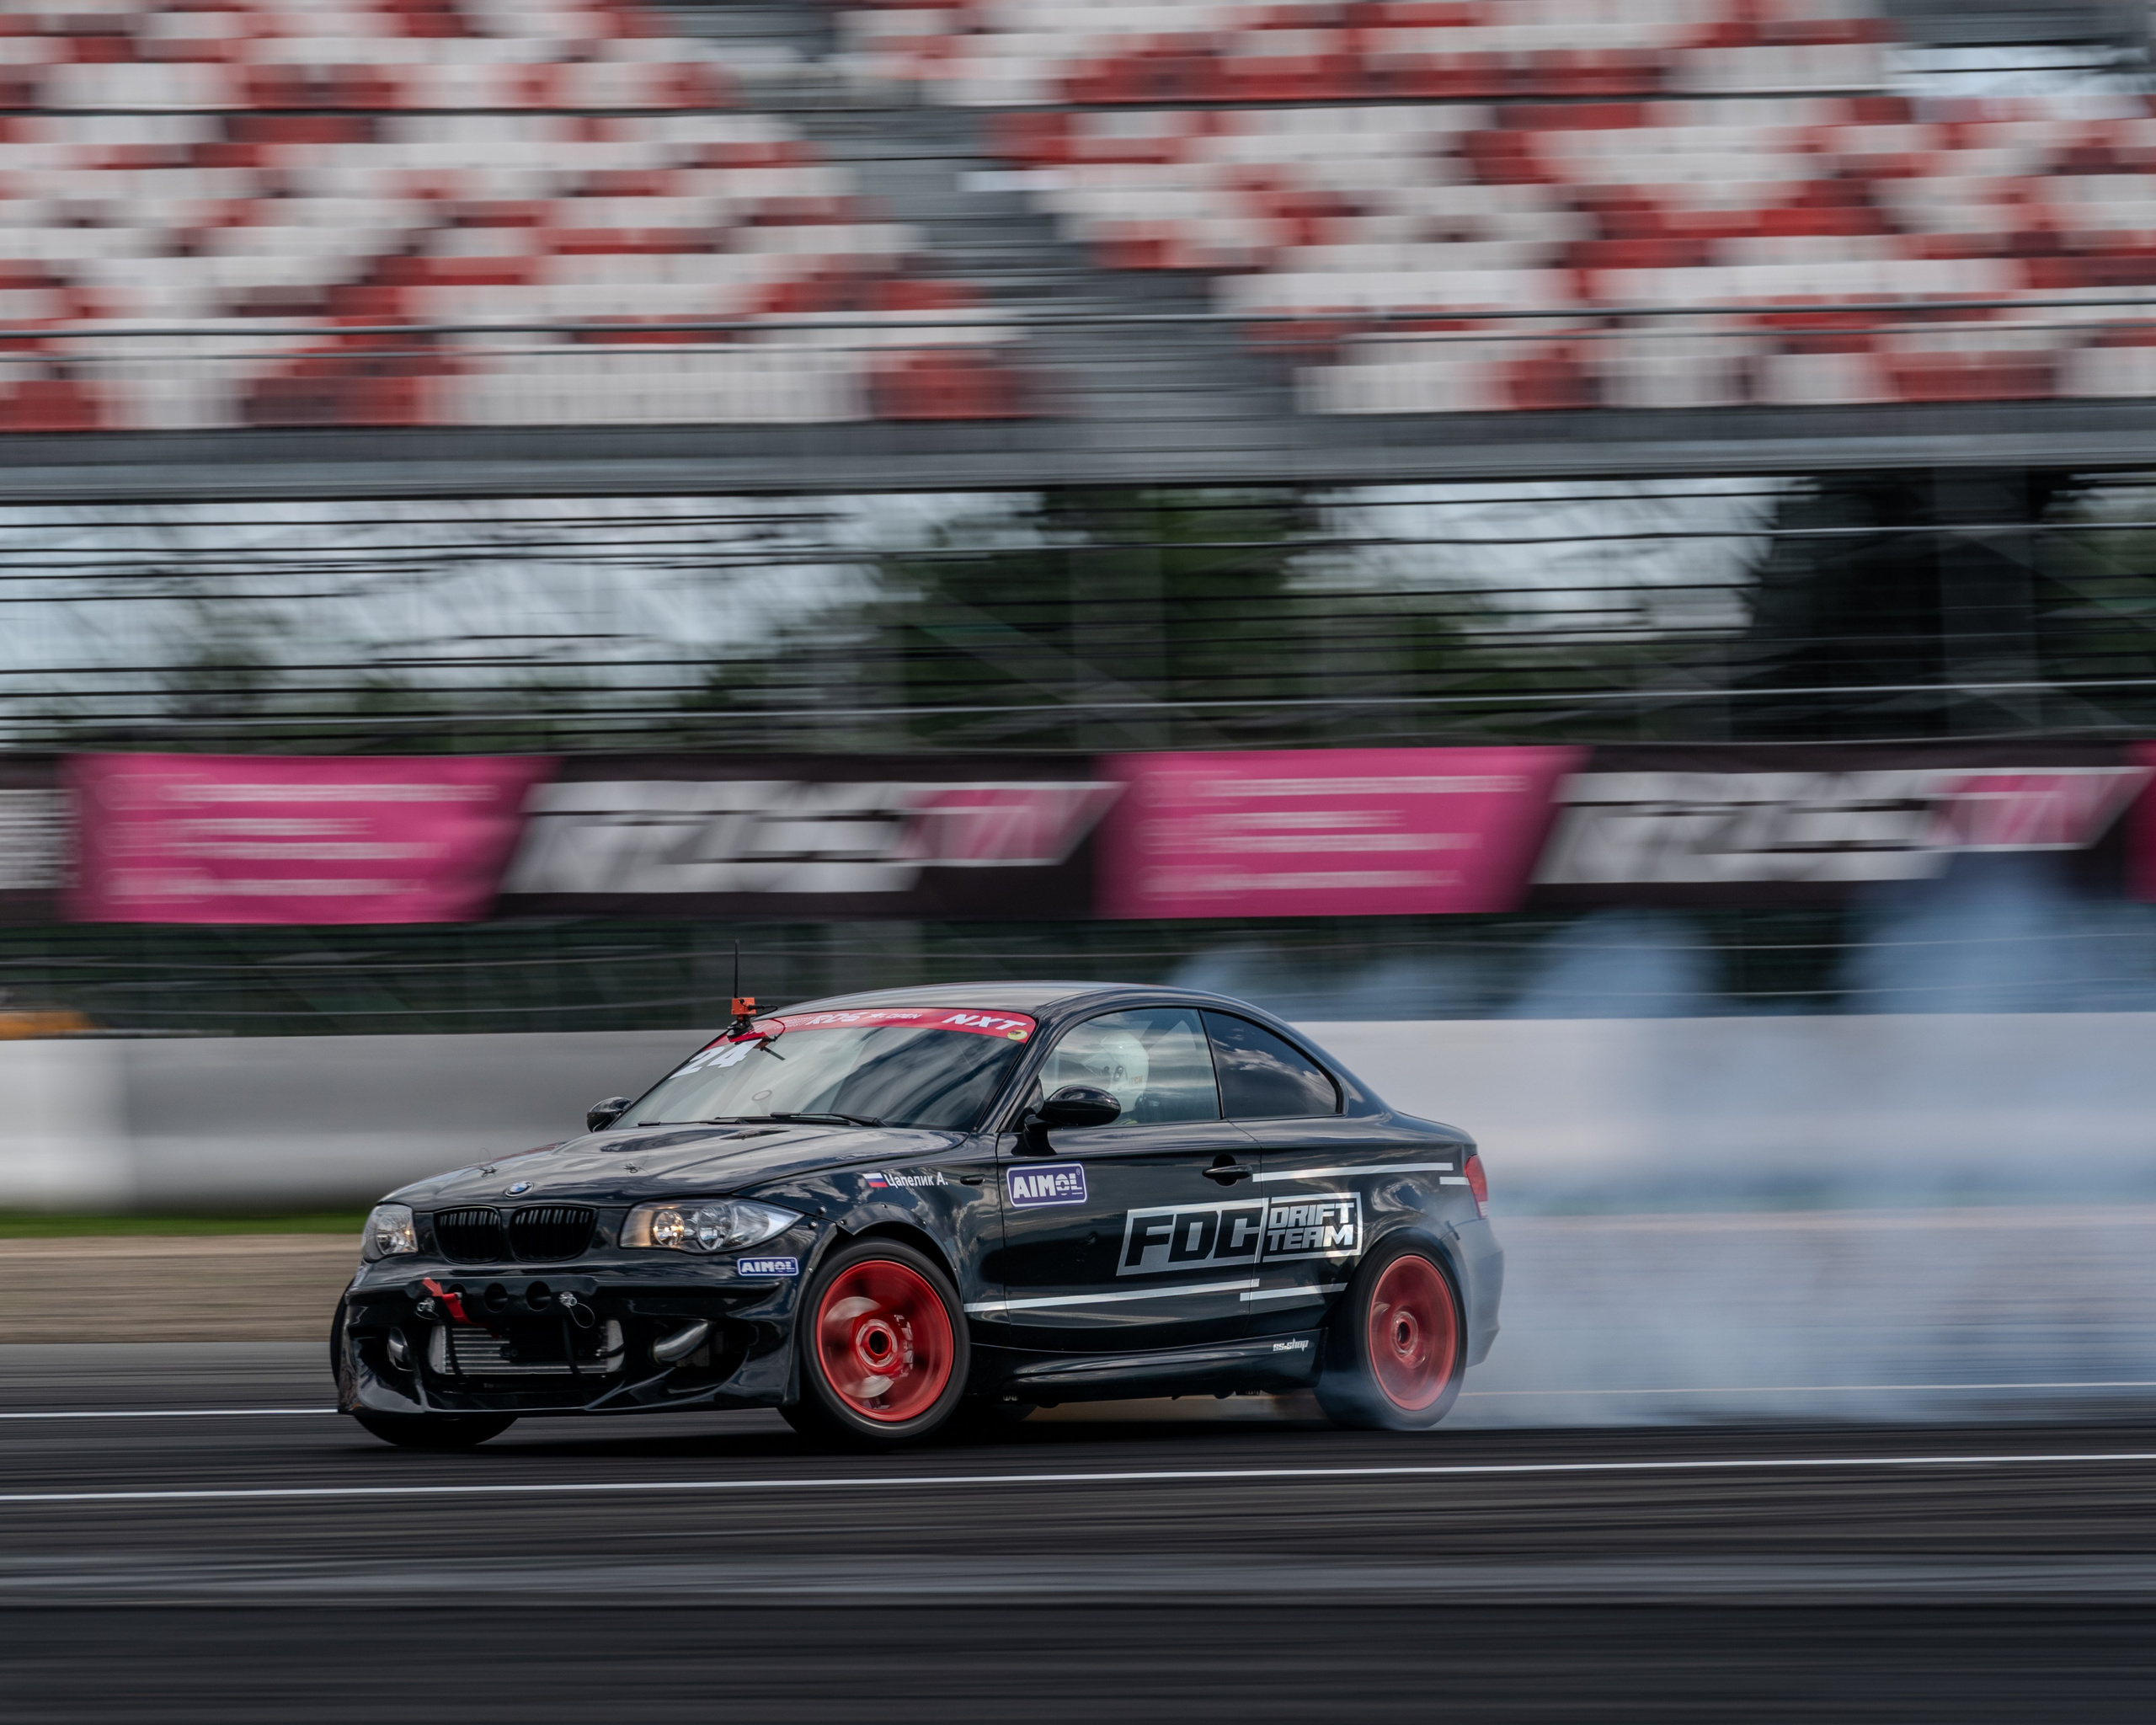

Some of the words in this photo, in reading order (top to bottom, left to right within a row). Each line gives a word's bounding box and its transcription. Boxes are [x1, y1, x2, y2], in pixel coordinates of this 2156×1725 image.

[941, 1013, 1027, 1031] NXT
[668, 1038, 764, 1080] 24
[883, 1173, 935, 1189] Цапелик
[1013, 1172, 1083, 1199] AIMOL
[1268, 1202, 1355, 1230] DRIFT
[1267, 1224, 1354, 1252] TEAM
[741, 1261, 796, 1273] AIMOL
